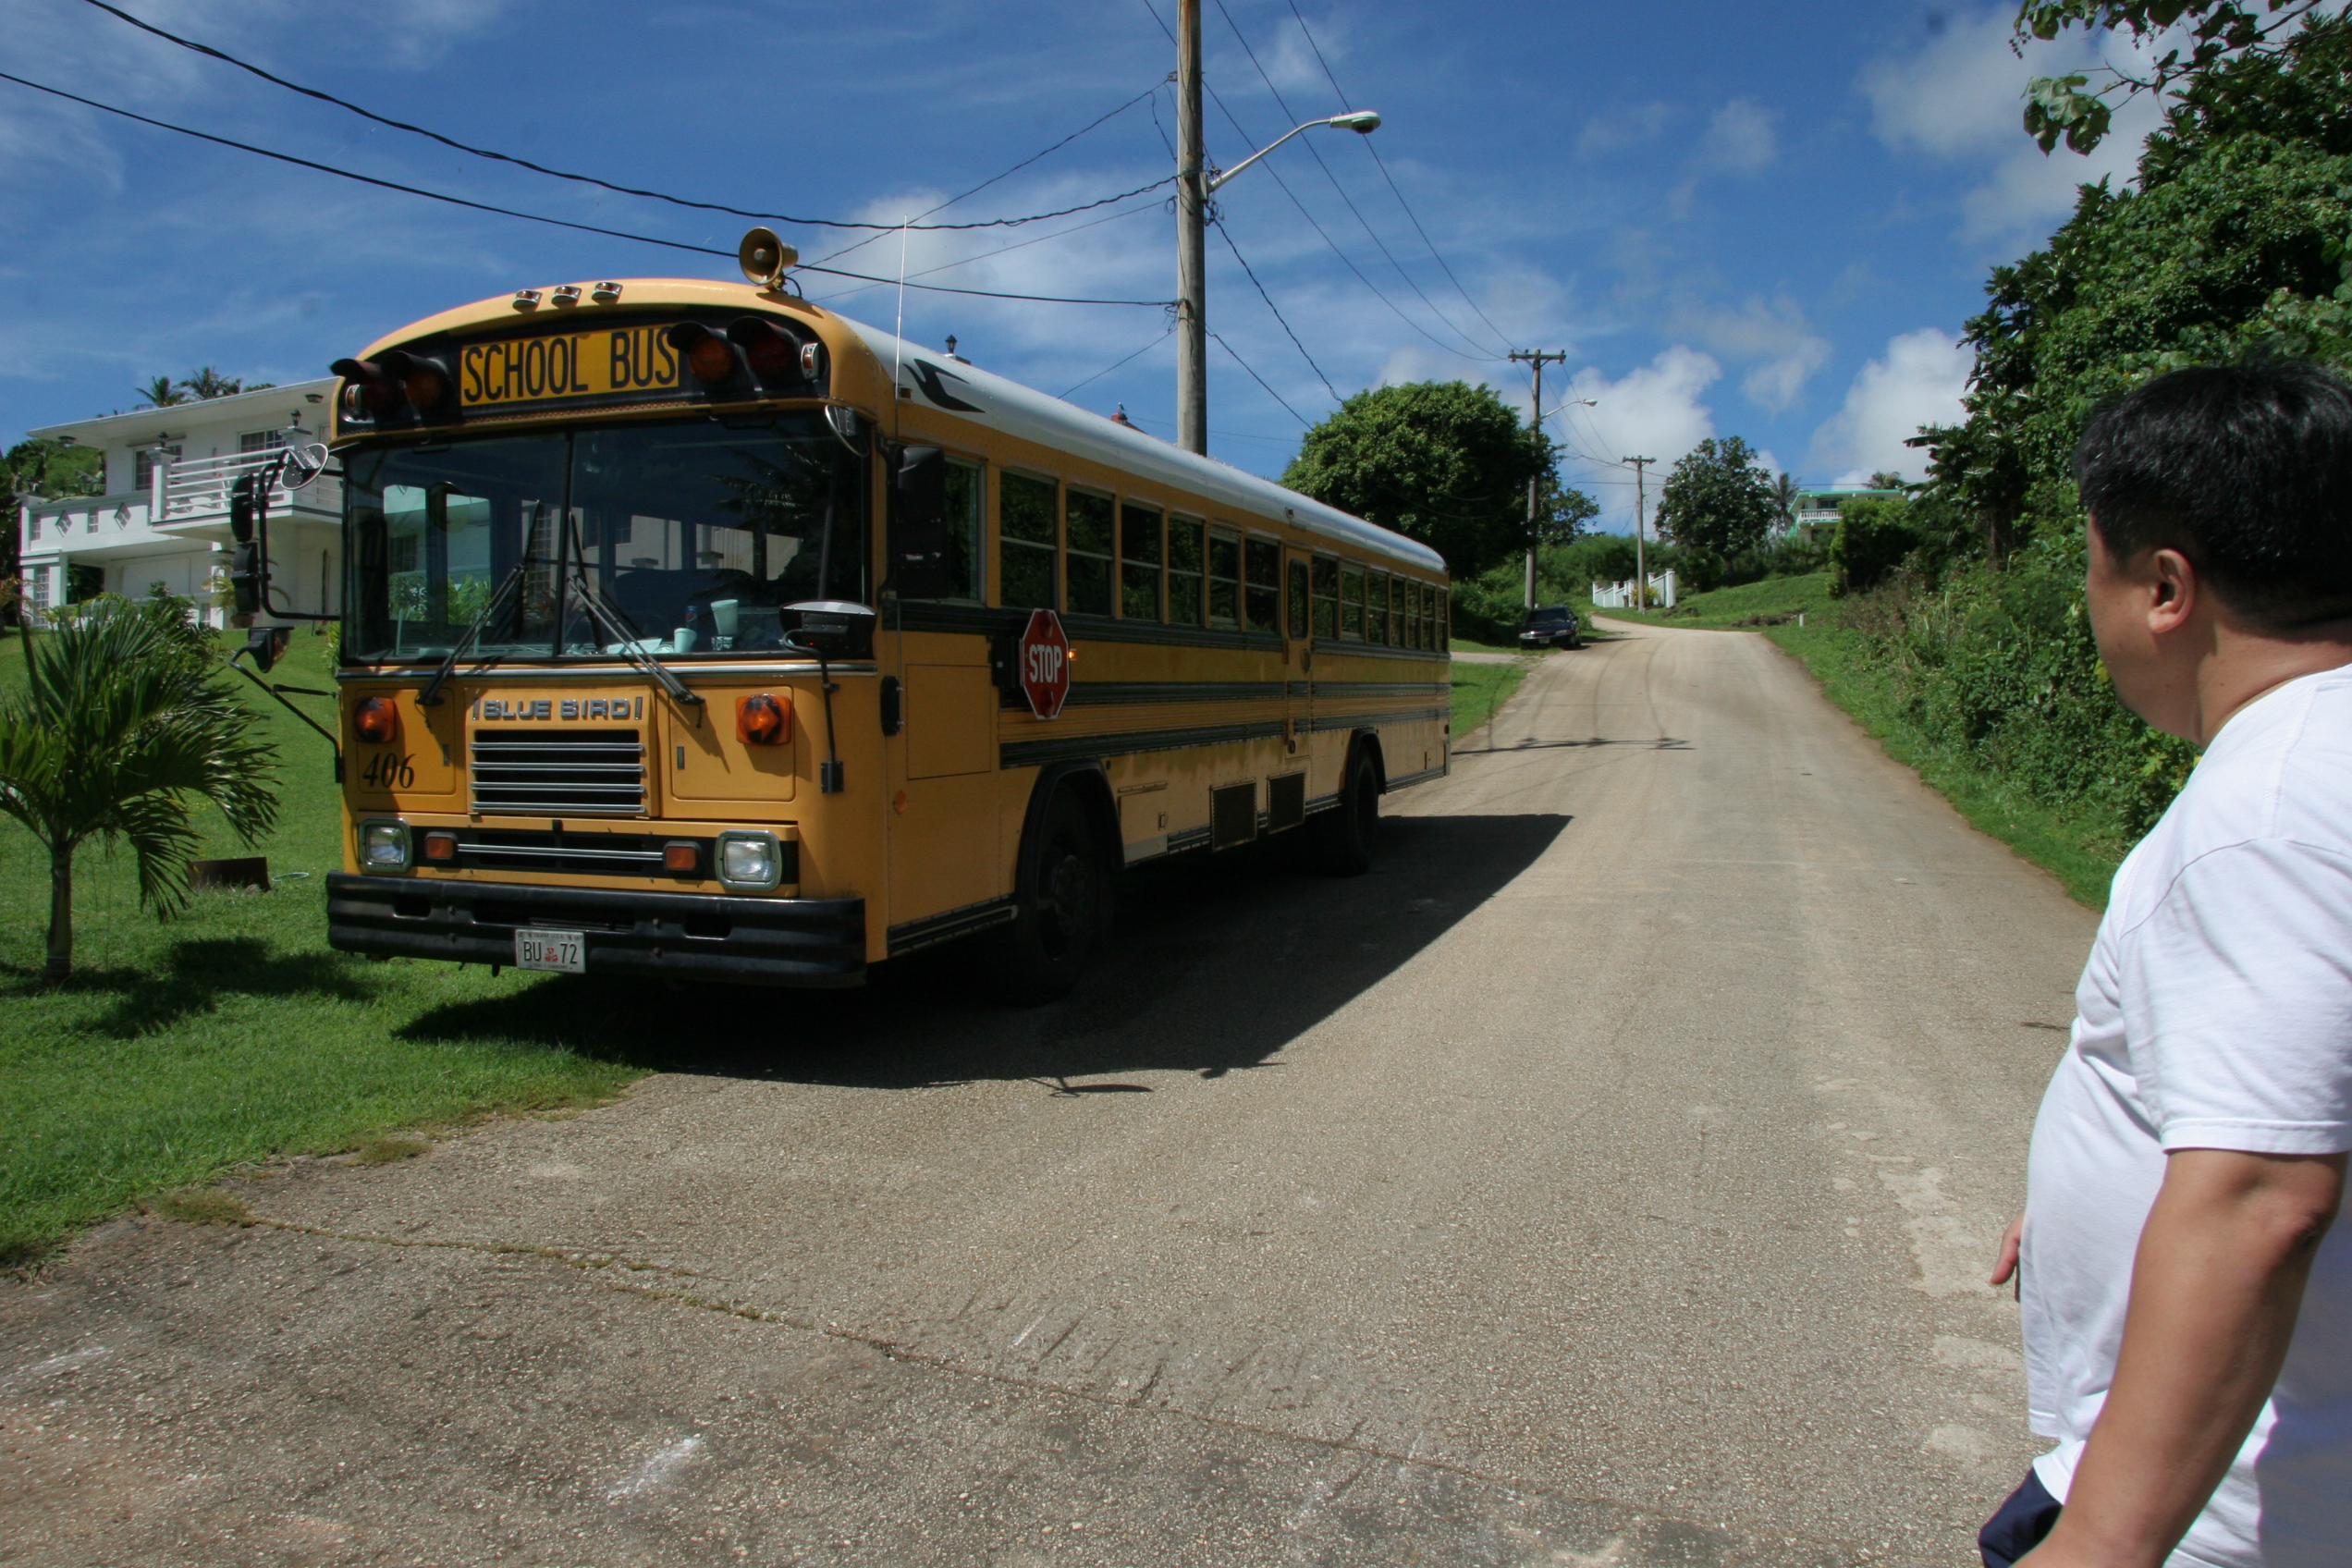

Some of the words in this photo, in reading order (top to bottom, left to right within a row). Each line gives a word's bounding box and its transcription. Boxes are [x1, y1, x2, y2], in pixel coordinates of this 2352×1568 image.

[464, 336, 589, 402] SCHOOL
[610, 326, 677, 389] BUS
[1029, 643, 1062, 683] STOP
[484, 699, 552, 718] BLUE
[560, 698, 631, 718] BIRD
[363, 753, 416, 789] 406
[523, 940, 542, 962] BU
[560, 942, 578, 964] 72
